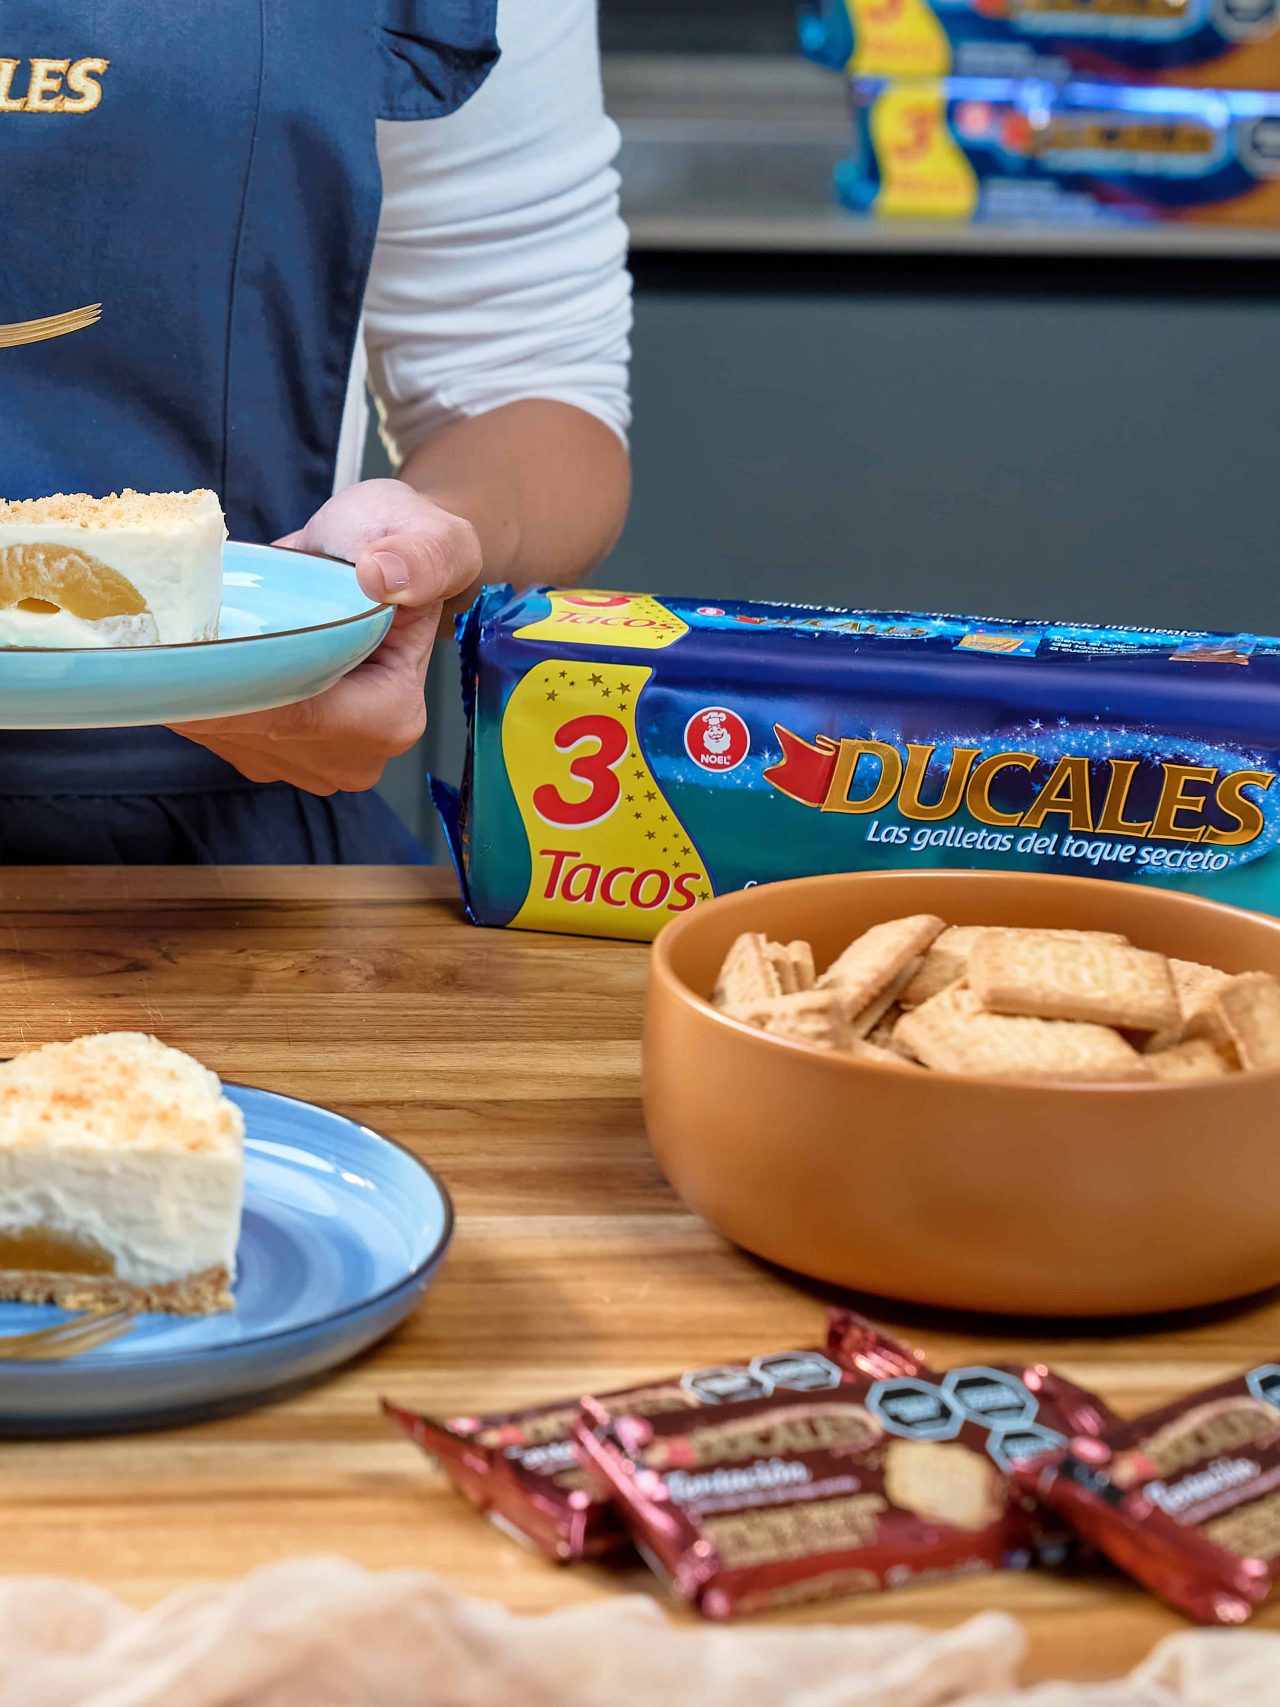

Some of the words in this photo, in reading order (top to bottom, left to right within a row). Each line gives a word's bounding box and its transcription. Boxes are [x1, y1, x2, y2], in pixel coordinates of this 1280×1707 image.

[555, 610, 681, 630] Tacos
[532, 714, 630, 830] 3
[820, 737, 1277, 846] DUCALES
[866, 820, 910, 845] Las
[911, 826, 1015, 852] galletas
[1016, 832, 1059, 855] del
[1061, 835, 1136, 865] toque
[1135, 845, 1229, 871] secreto
[538, 849, 702, 913] Tacos
